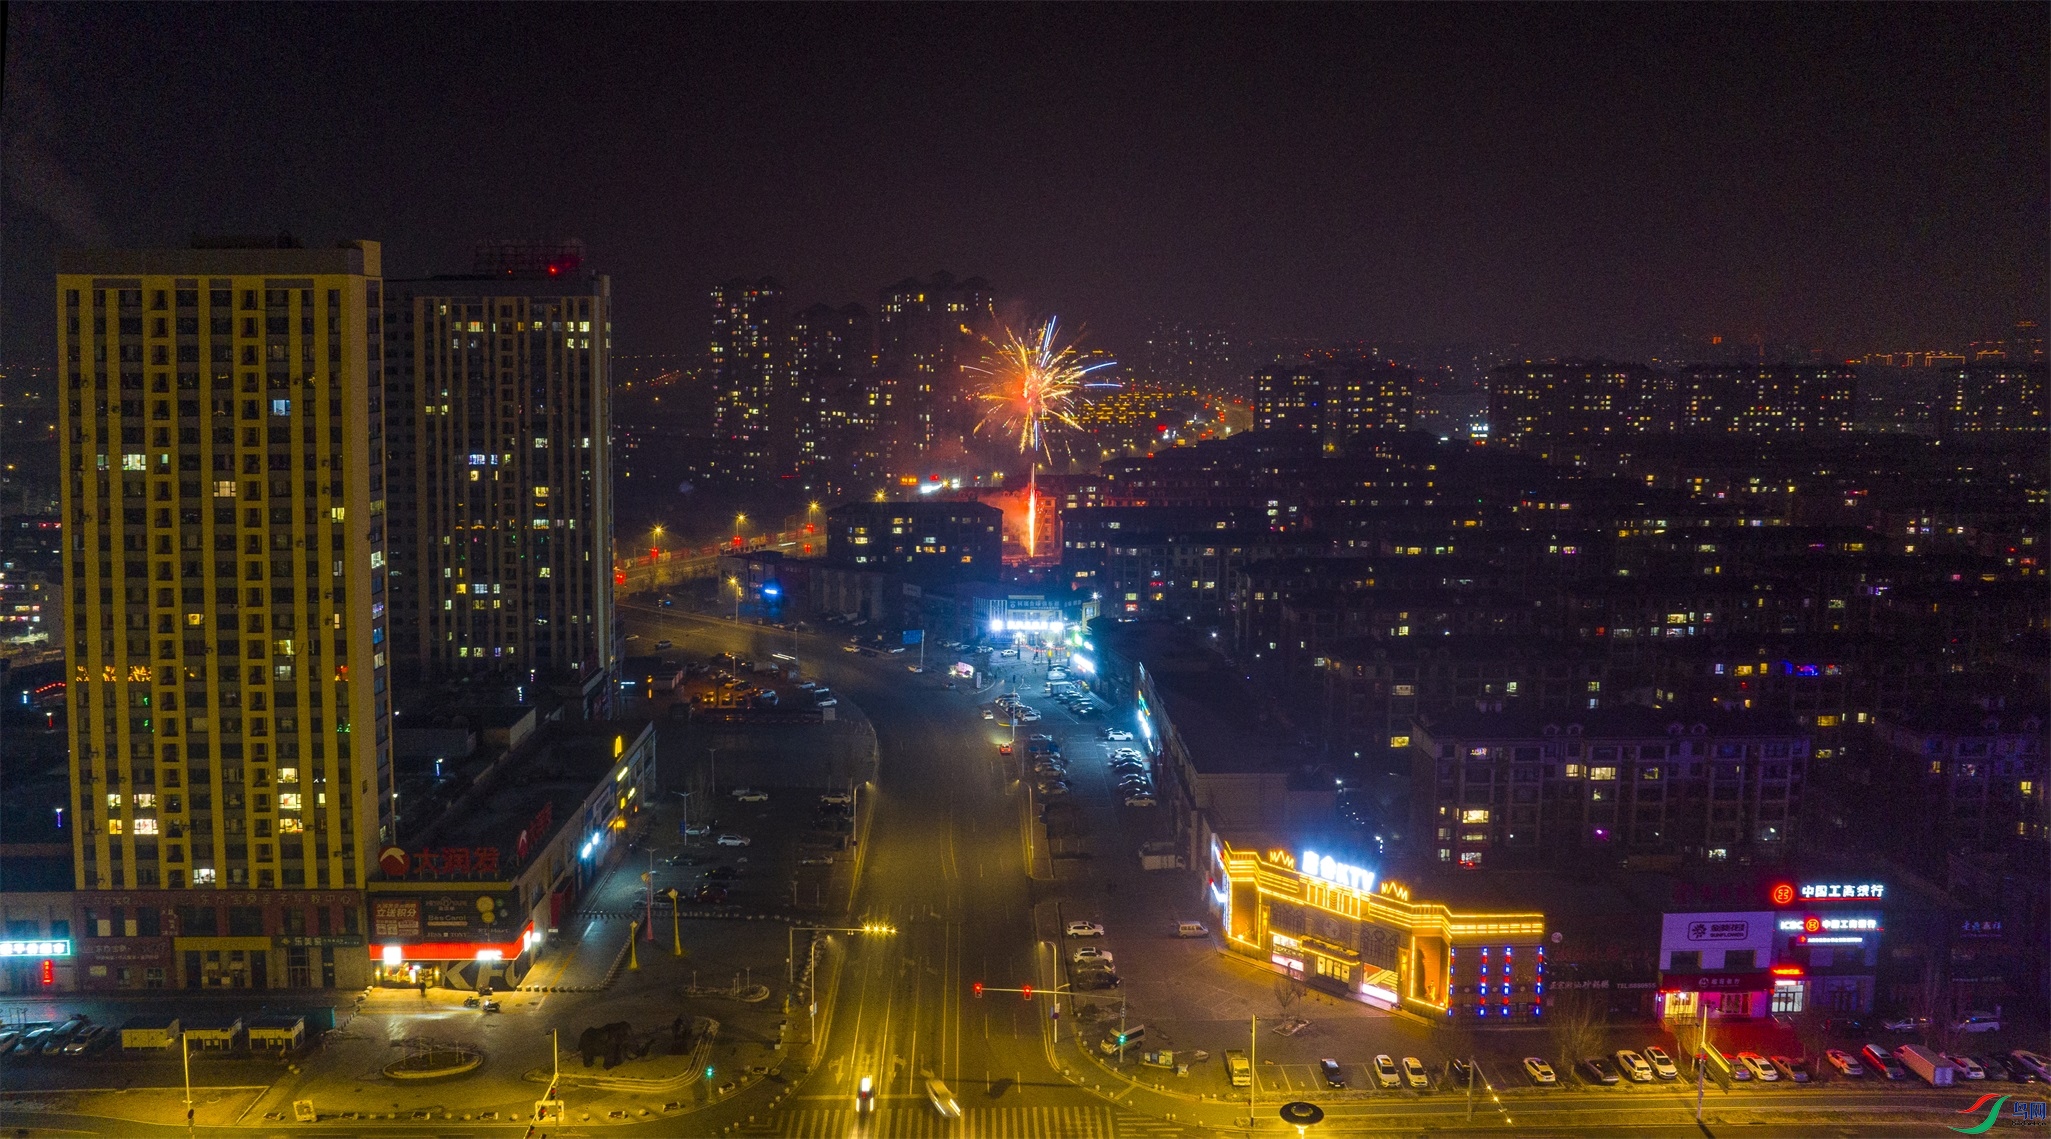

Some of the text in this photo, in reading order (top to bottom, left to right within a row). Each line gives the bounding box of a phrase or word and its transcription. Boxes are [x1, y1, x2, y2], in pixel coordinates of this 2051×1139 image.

[412, 847, 500, 874] 大润发
[1301, 850, 1375, 892] KTV
[1801, 884, 1884, 898] 中国工商银行
[376, 908, 417, 918] 立送积分
[1822, 919, 1877, 929] 中国工商银行
